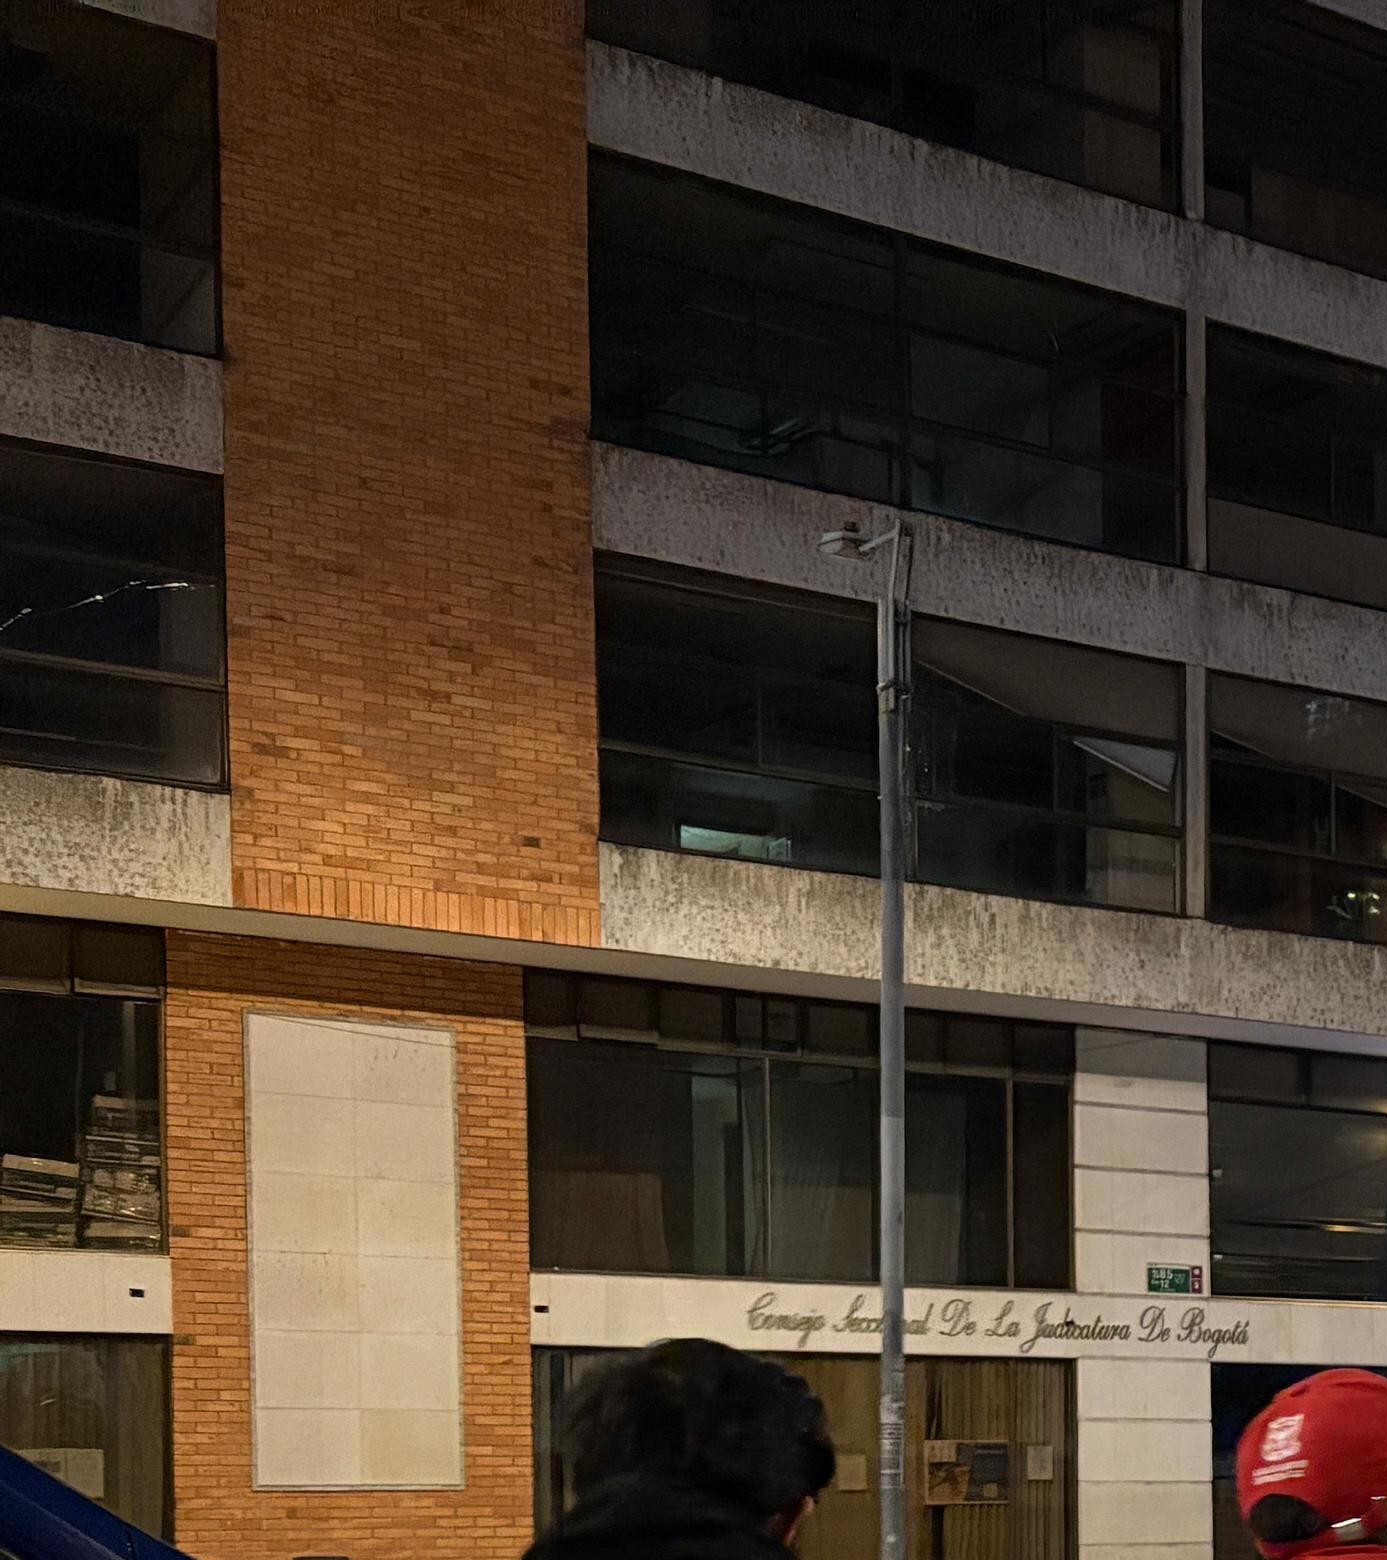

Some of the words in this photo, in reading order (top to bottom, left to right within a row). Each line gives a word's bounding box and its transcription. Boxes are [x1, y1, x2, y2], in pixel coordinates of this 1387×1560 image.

[939, 1298, 977, 1337] De
[987, 1300, 1020, 1338] La
[1138, 1305, 1171, 1343] De
[1177, 1307, 1249, 1359] Bogotá
